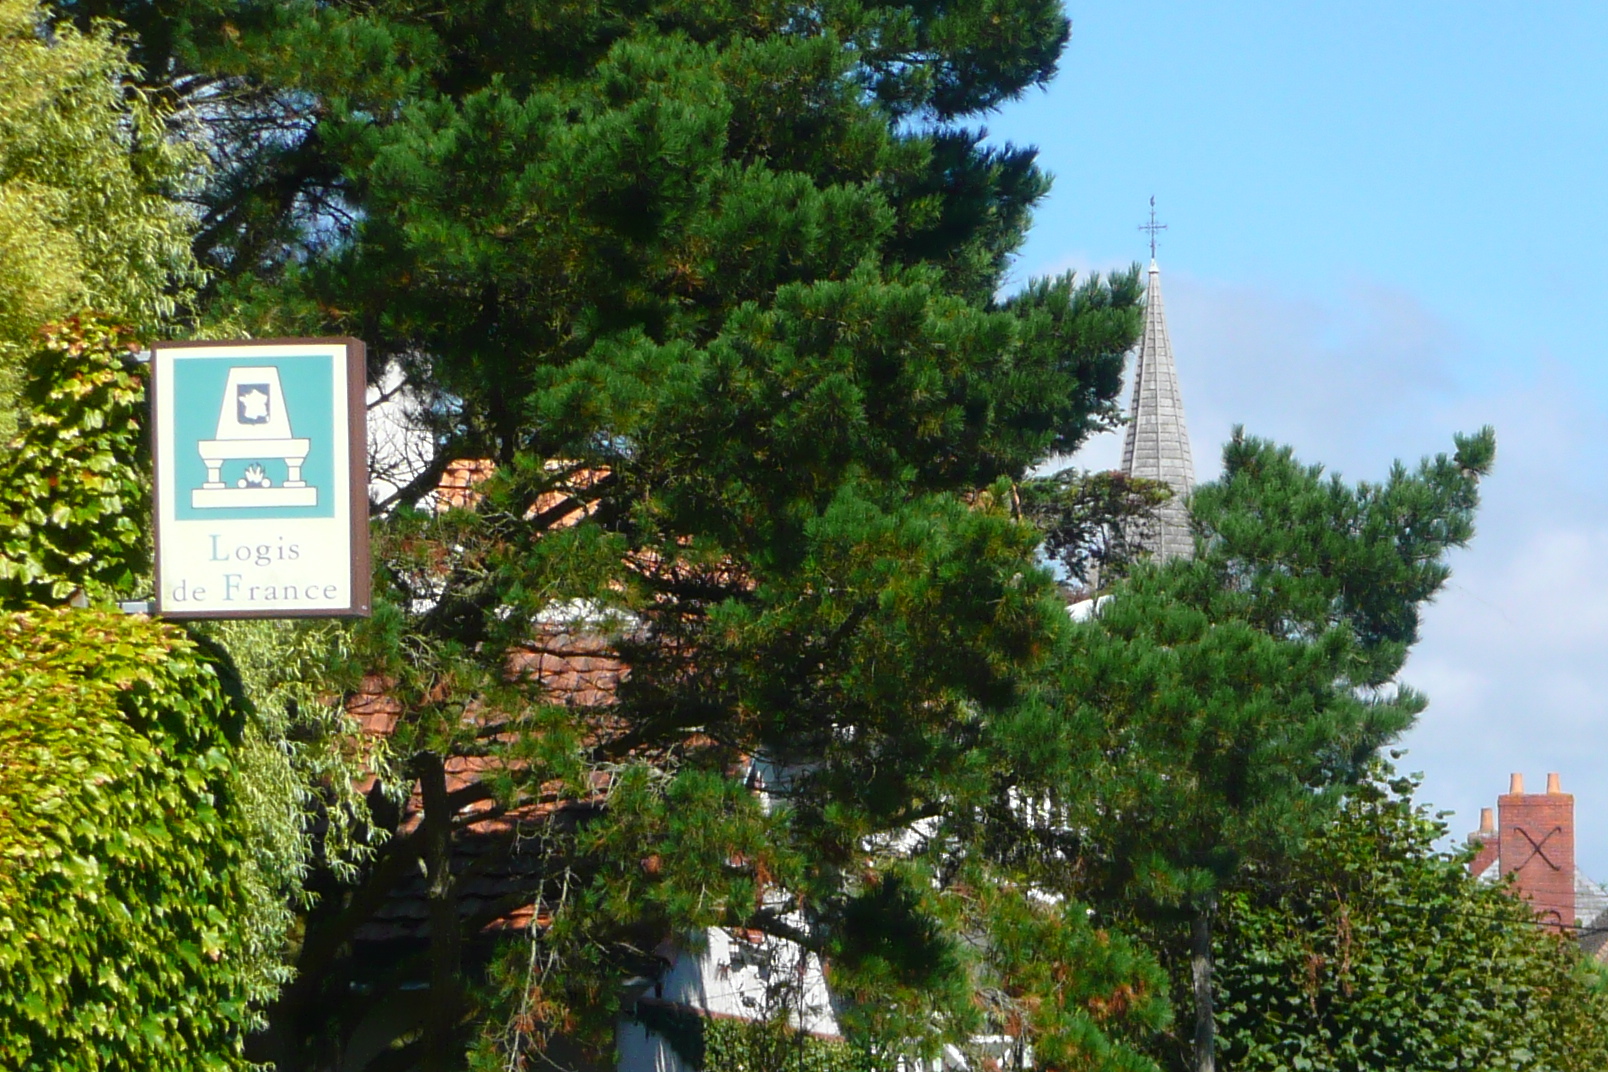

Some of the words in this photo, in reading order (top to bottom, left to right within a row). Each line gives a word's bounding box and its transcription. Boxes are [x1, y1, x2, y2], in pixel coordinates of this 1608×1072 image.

[208, 534, 300, 566] Logis
[172, 579, 206, 603] de
[223, 574, 338, 602] France
